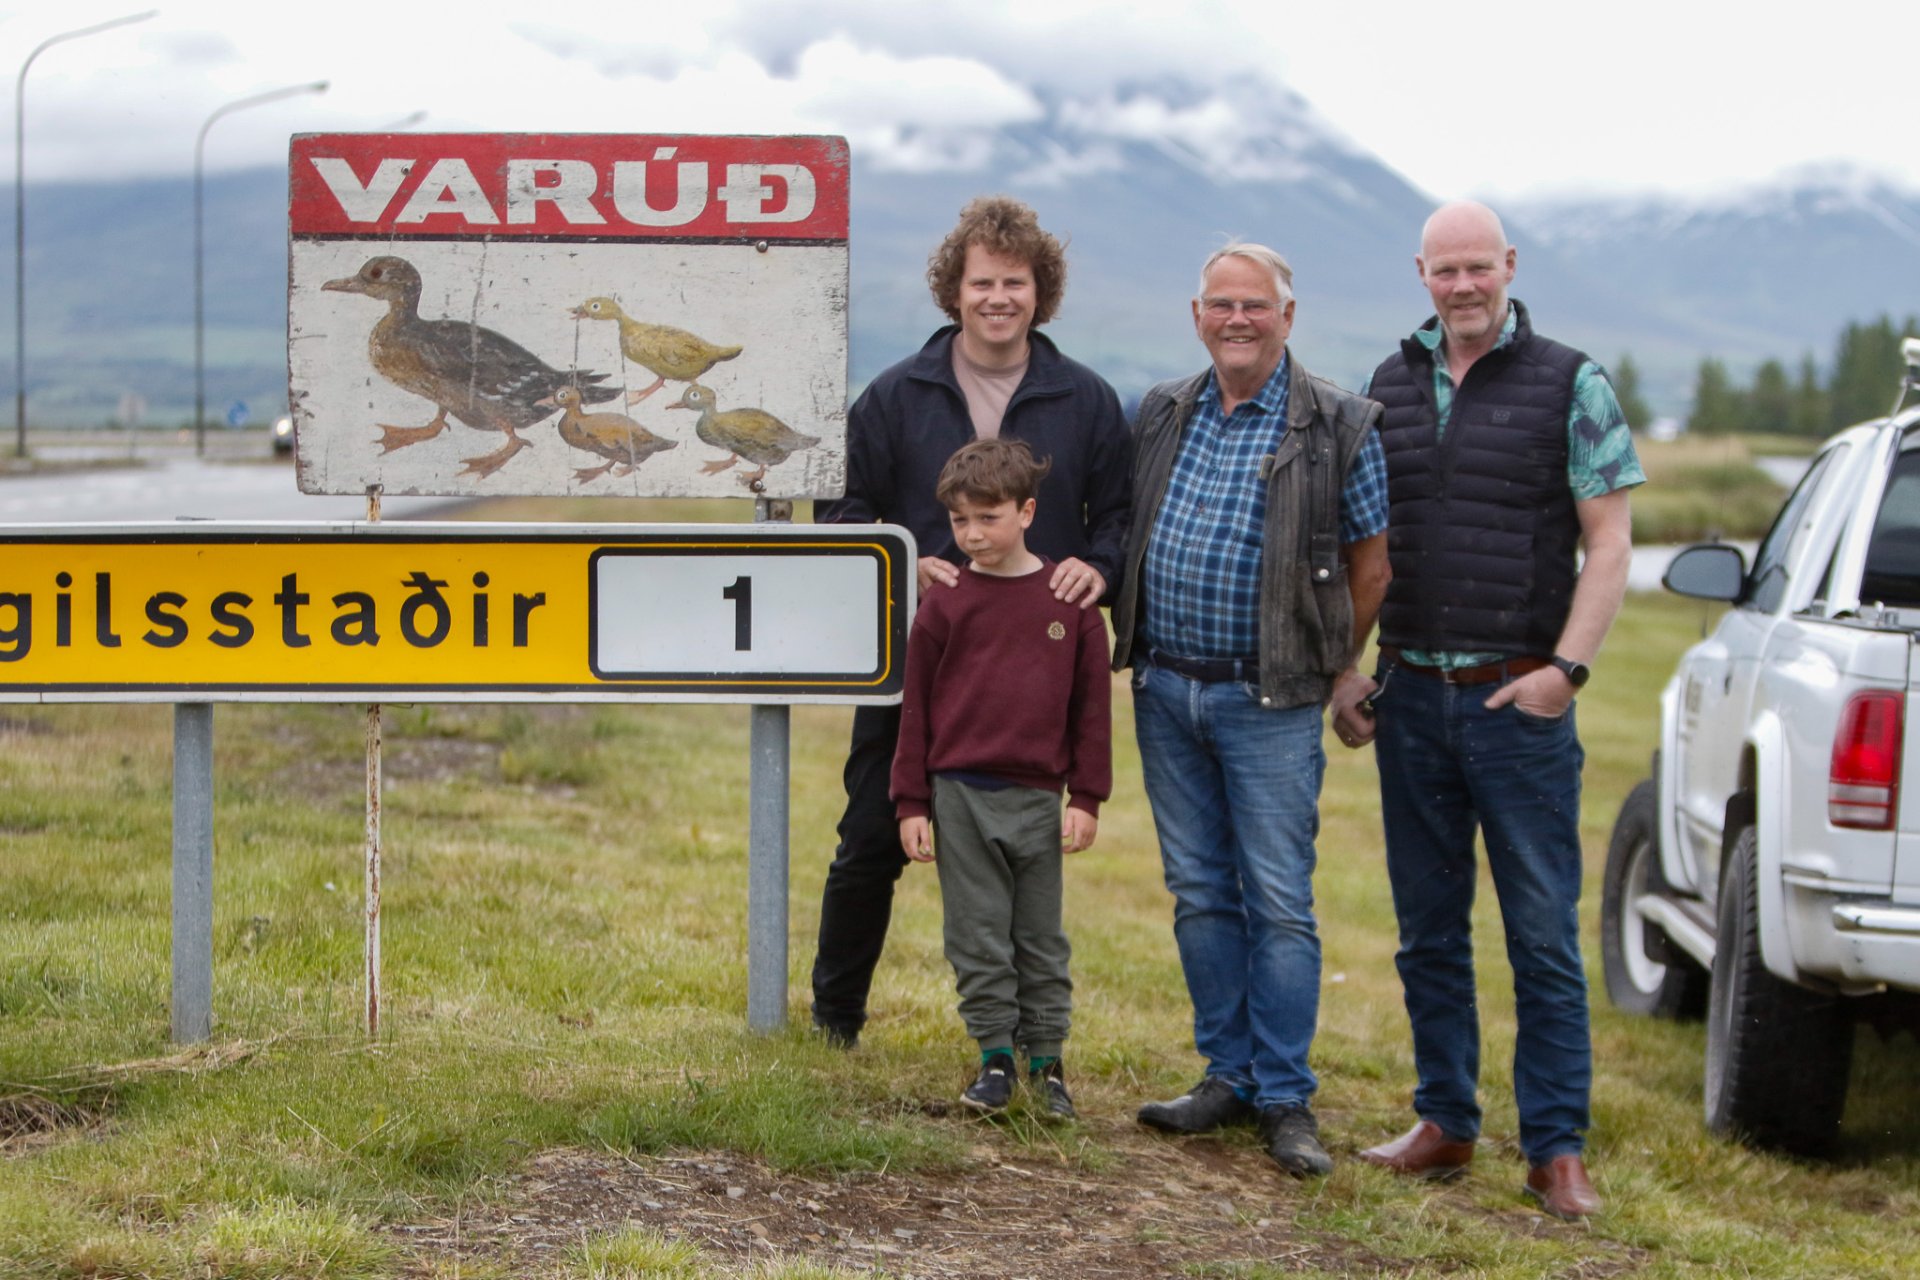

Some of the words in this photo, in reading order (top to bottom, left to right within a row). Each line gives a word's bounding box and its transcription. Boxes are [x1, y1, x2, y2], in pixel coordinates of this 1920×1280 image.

[309, 146, 817, 227] VARÚÐ
[0, 571, 546, 662] gilsstaðir
[723, 576, 752, 651] 1
